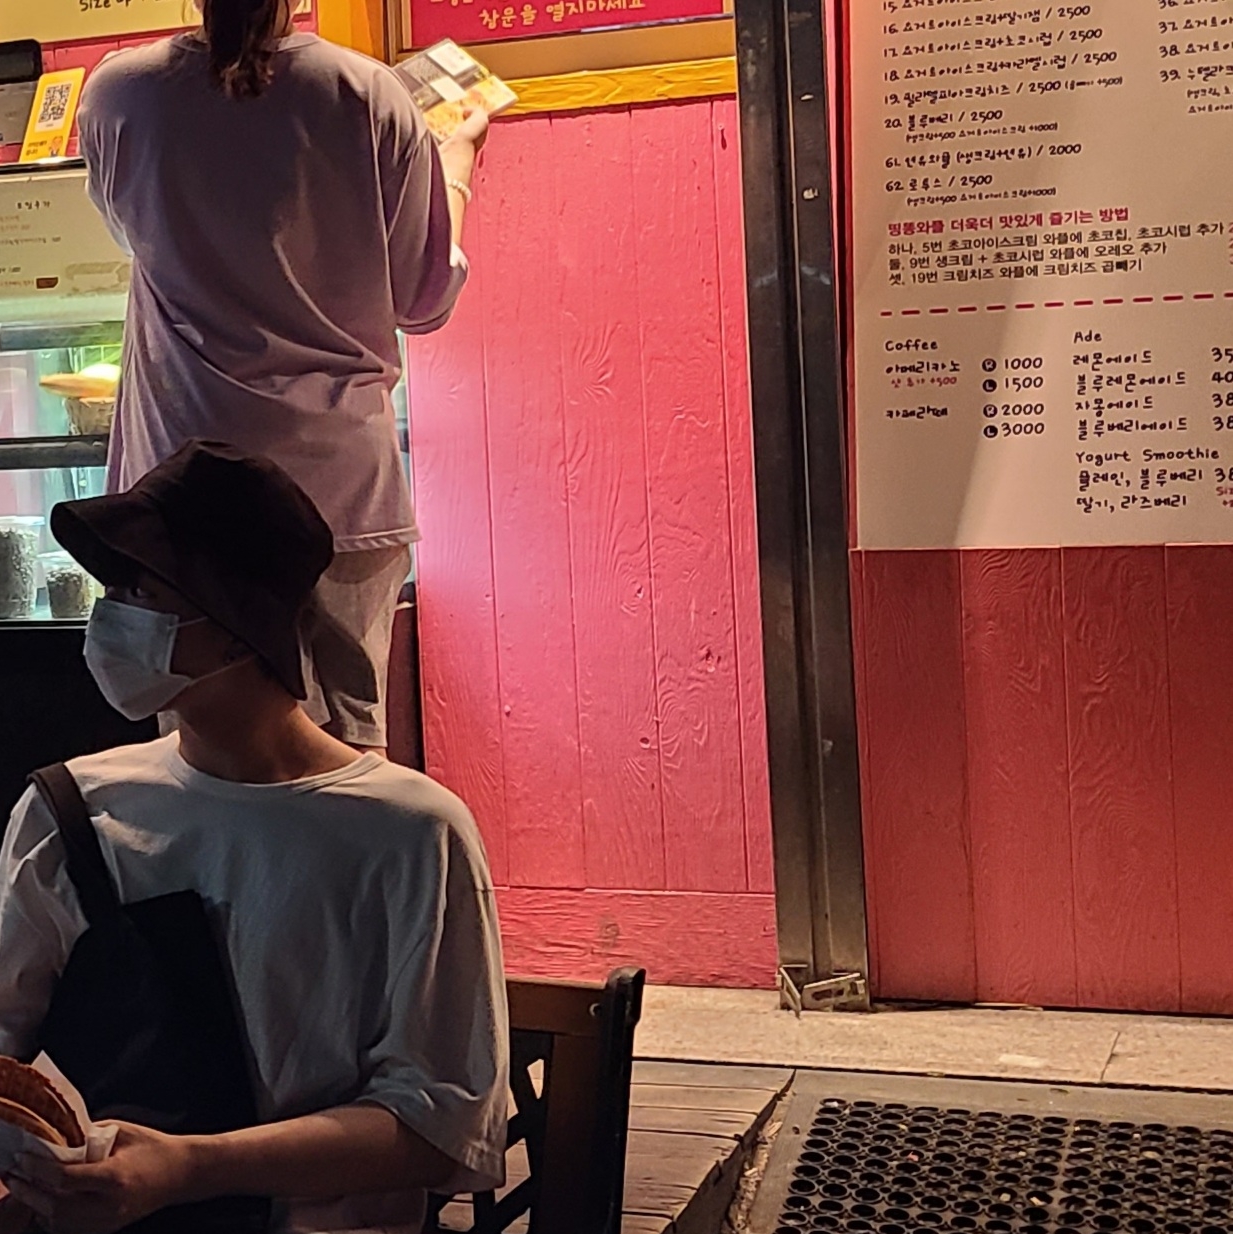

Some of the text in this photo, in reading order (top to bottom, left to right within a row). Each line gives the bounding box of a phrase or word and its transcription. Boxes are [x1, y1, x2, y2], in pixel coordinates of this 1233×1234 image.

[1058, 5, 1091, 20] 2500
[1069, 28, 1103, 43] 2500
[1084, 51, 1118, 66] 2500
[1028, 80, 1062, 95] 2500
[908, 113, 953, 132] 블루베리
[970, 110, 1004, 124] 2500
[1048, 144, 1082, 156] 2000
[960, 174, 994, 188] 2500
[951, 216, 993, 232] 더욱더
[999, 213, 1043, 228] 맛있게
[1049, 210, 1094, 226] 즐기는
[1099, 207, 1130, 222] 방법
[922, 240, 942, 253] 5번
[947, 234, 1038, 250] 초코아이스크림
[1043, 231, 1082, 246] 와플에
[1136, 224, 1192, 240] 초코시럽
[1196, 222, 1224, 236] 추가
[909, 256, 930, 268] 9번
[935, 254, 974, 268] 생크림
[992, 249, 1044, 264] 초코시럽
[1049, 246, 1089, 260] 와플에
[1094, 244, 1136, 258] 오레오
[1140, 242, 1167, 256] 추가
[912, 272, 938, 284] 19번
[942, 268, 994, 282] 크림치즈
[1000, 264, 1038, 280] 와플에
[1043, 262, 1097, 276] 크림치즈
[884, 338, 938, 352] Coffee
[1073, 330, 1102, 344] Ade
[886, 360, 960, 374] 아메리카노
[1004, 357, 1043, 370] 1000
[1073, 350, 1152, 372] 레몬에이드
[1004, 376, 1044, 393] 1500
[1077, 371, 1186, 396] 블루레몬에이드
[1001, 402, 1045, 416] 2000
[1075, 396, 1153, 418] 자몽에이드
[1000, 422, 1045, 438] 3000
[1078, 417, 1188, 441] 블루베리에이드
[1076, 447, 1220, 467] Yogurt Smoothie
[1140, 468, 1203, 490] 블루베리
[1120, 494, 1187, 510] 라즈베리
